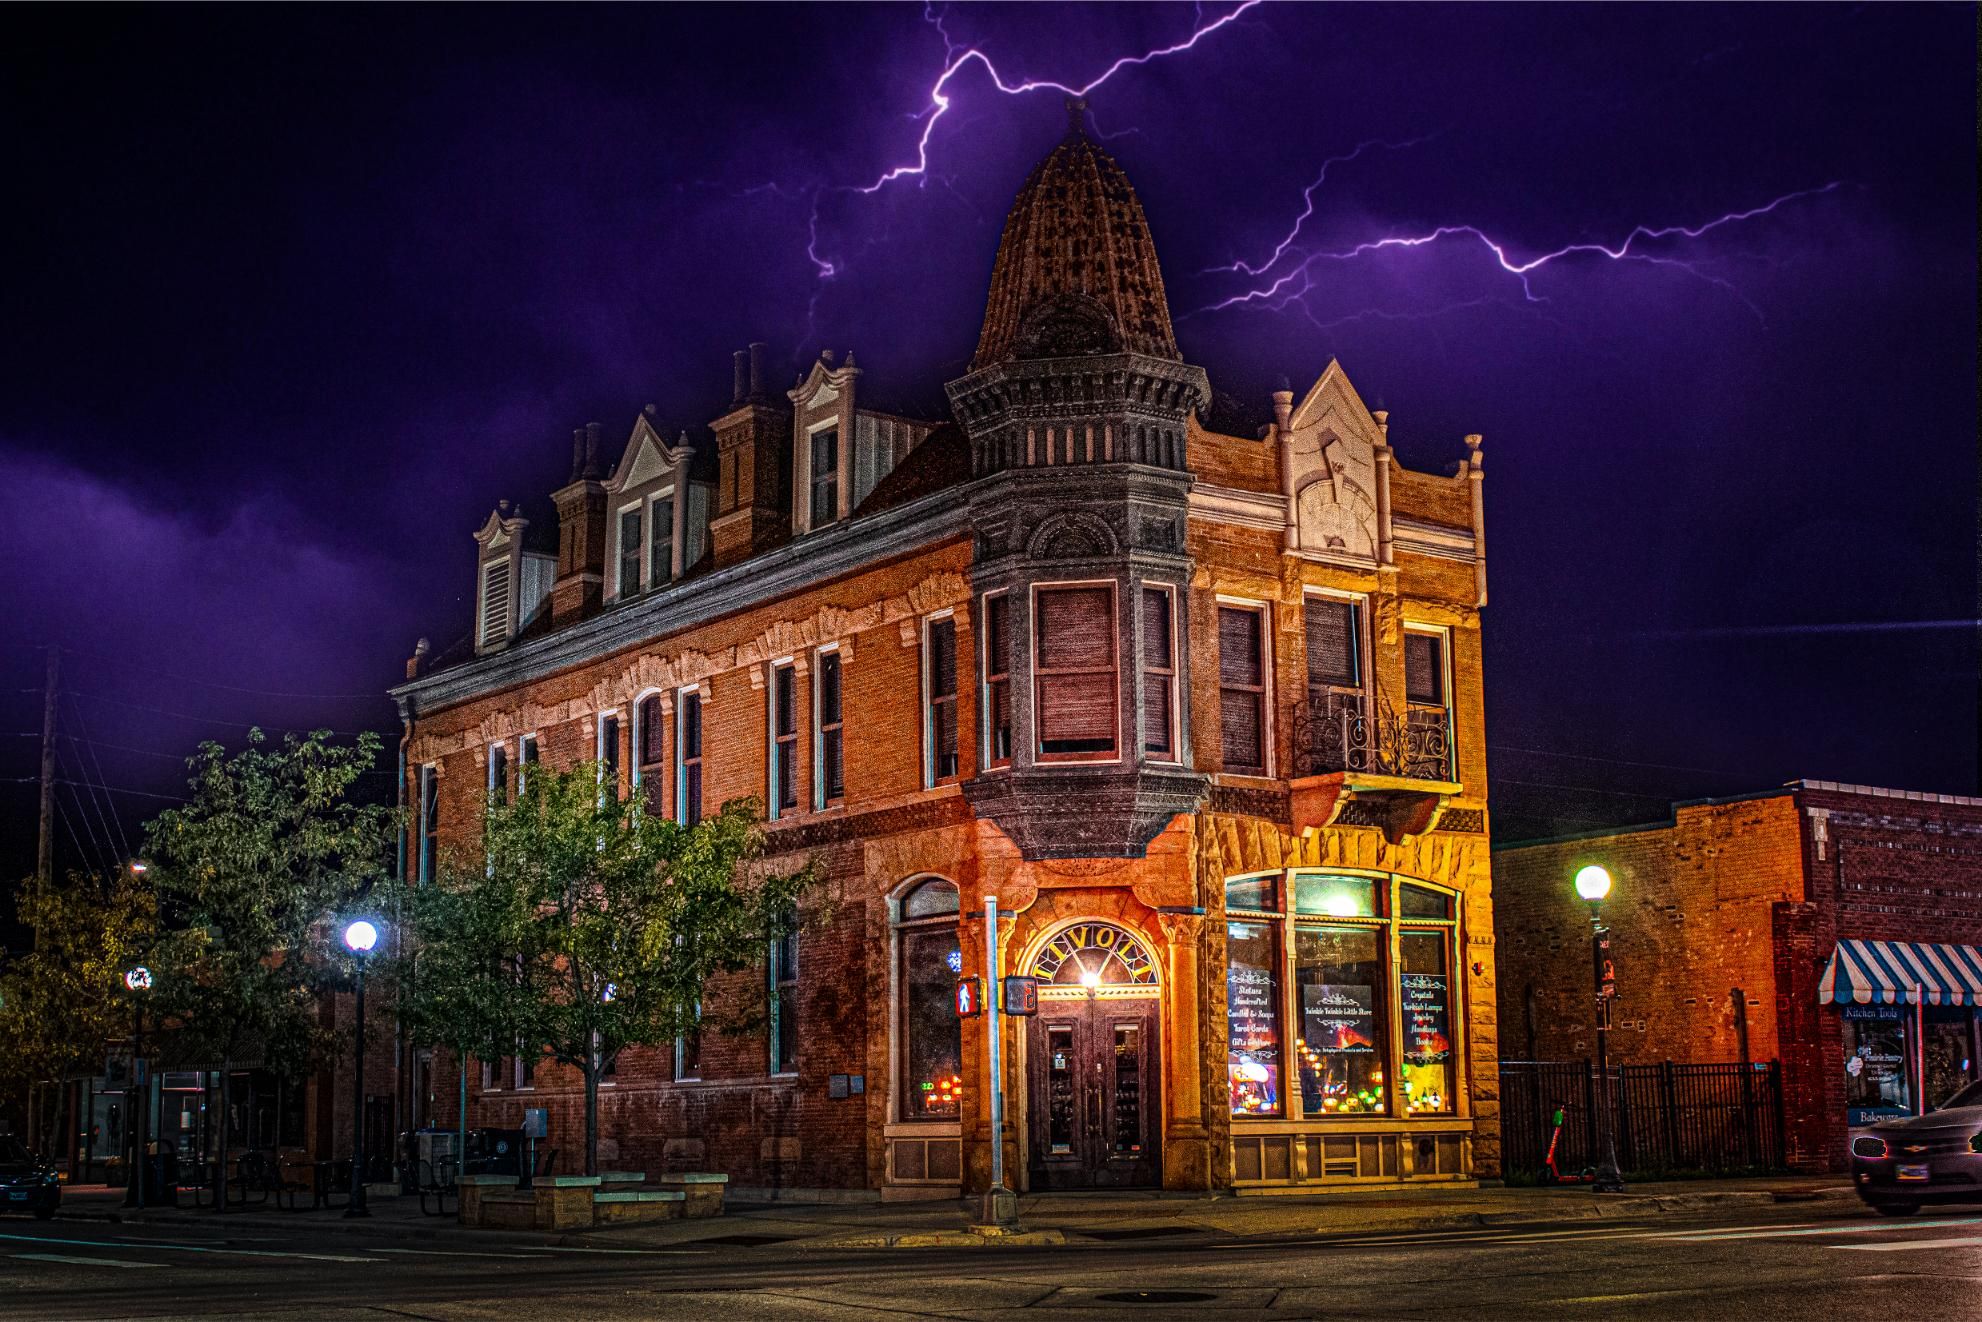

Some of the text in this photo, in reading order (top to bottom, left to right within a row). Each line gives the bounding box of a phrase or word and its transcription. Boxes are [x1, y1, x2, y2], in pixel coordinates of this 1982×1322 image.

[1033, 927, 1152, 979] TIVOLI
[1411, 990, 1434, 1001] Crystals
[1233, 998, 1267, 1006] Handcrafted
[1402, 1002, 1442, 1013] Turkish Lamps
[1305, 1007, 1324, 1015] Twinkle
[1324, 1007, 1343, 1015] Twinkle
[1344, 1007, 1357, 1015] Little
[1846, 1007, 1898, 1018] Kitchen Tools
[1413, 1012, 1434, 1023] Jewelry
[1233, 1023, 1269, 1032] Tarot Cards
[1411, 1024, 1437, 1035] Handbags
[1232, 1038, 1246, 1046] Gifts
[1860, 1111, 1899, 1122] Bakeware
